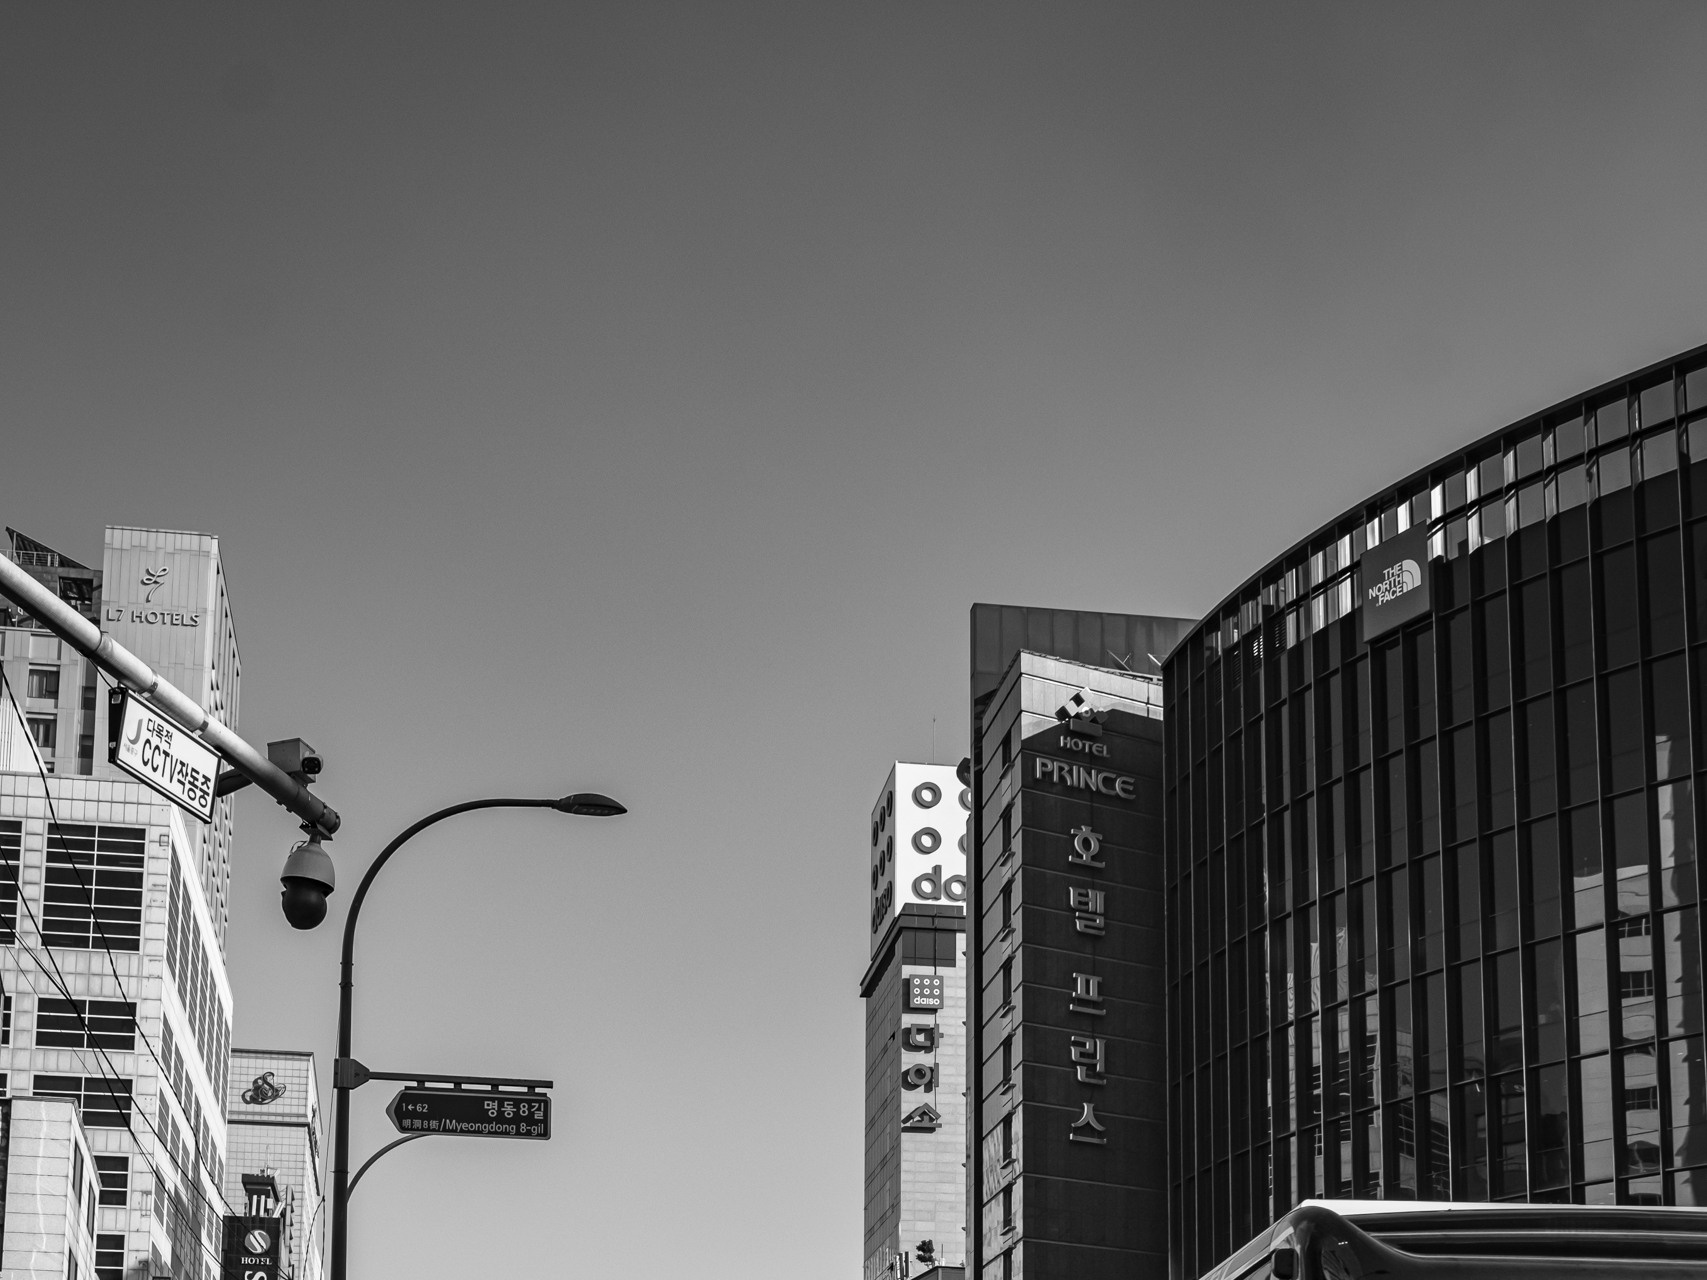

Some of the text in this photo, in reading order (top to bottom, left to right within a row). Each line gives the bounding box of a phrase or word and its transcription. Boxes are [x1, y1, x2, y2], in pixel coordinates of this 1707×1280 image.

[1383, 562, 1402, 580] THE
[1368, 573, 1403, 599] NORTH
[1378, 584, 1403, 606] FACE
[106, 608, 200, 627] L7 HOTELS
[147, 718, 173, 749] 다목적
[1060, 735, 1111, 758] HOTEL
[141, 738, 212, 809] CCTV작동중
[1036, 757, 1137, 800] PRINCE
[1068, 825, 1107, 1144] 호텔 프린스
[913, 995, 940, 1006] daiso
[910, 1023, 945, 1129] 다이소
[416, 1103, 429, 1112] 62
[484, 1100, 544, 1120] 명동8길
[520, 1123, 544, 1135] 8-gil
[241, 1257, 272, 1265] HOTEL
